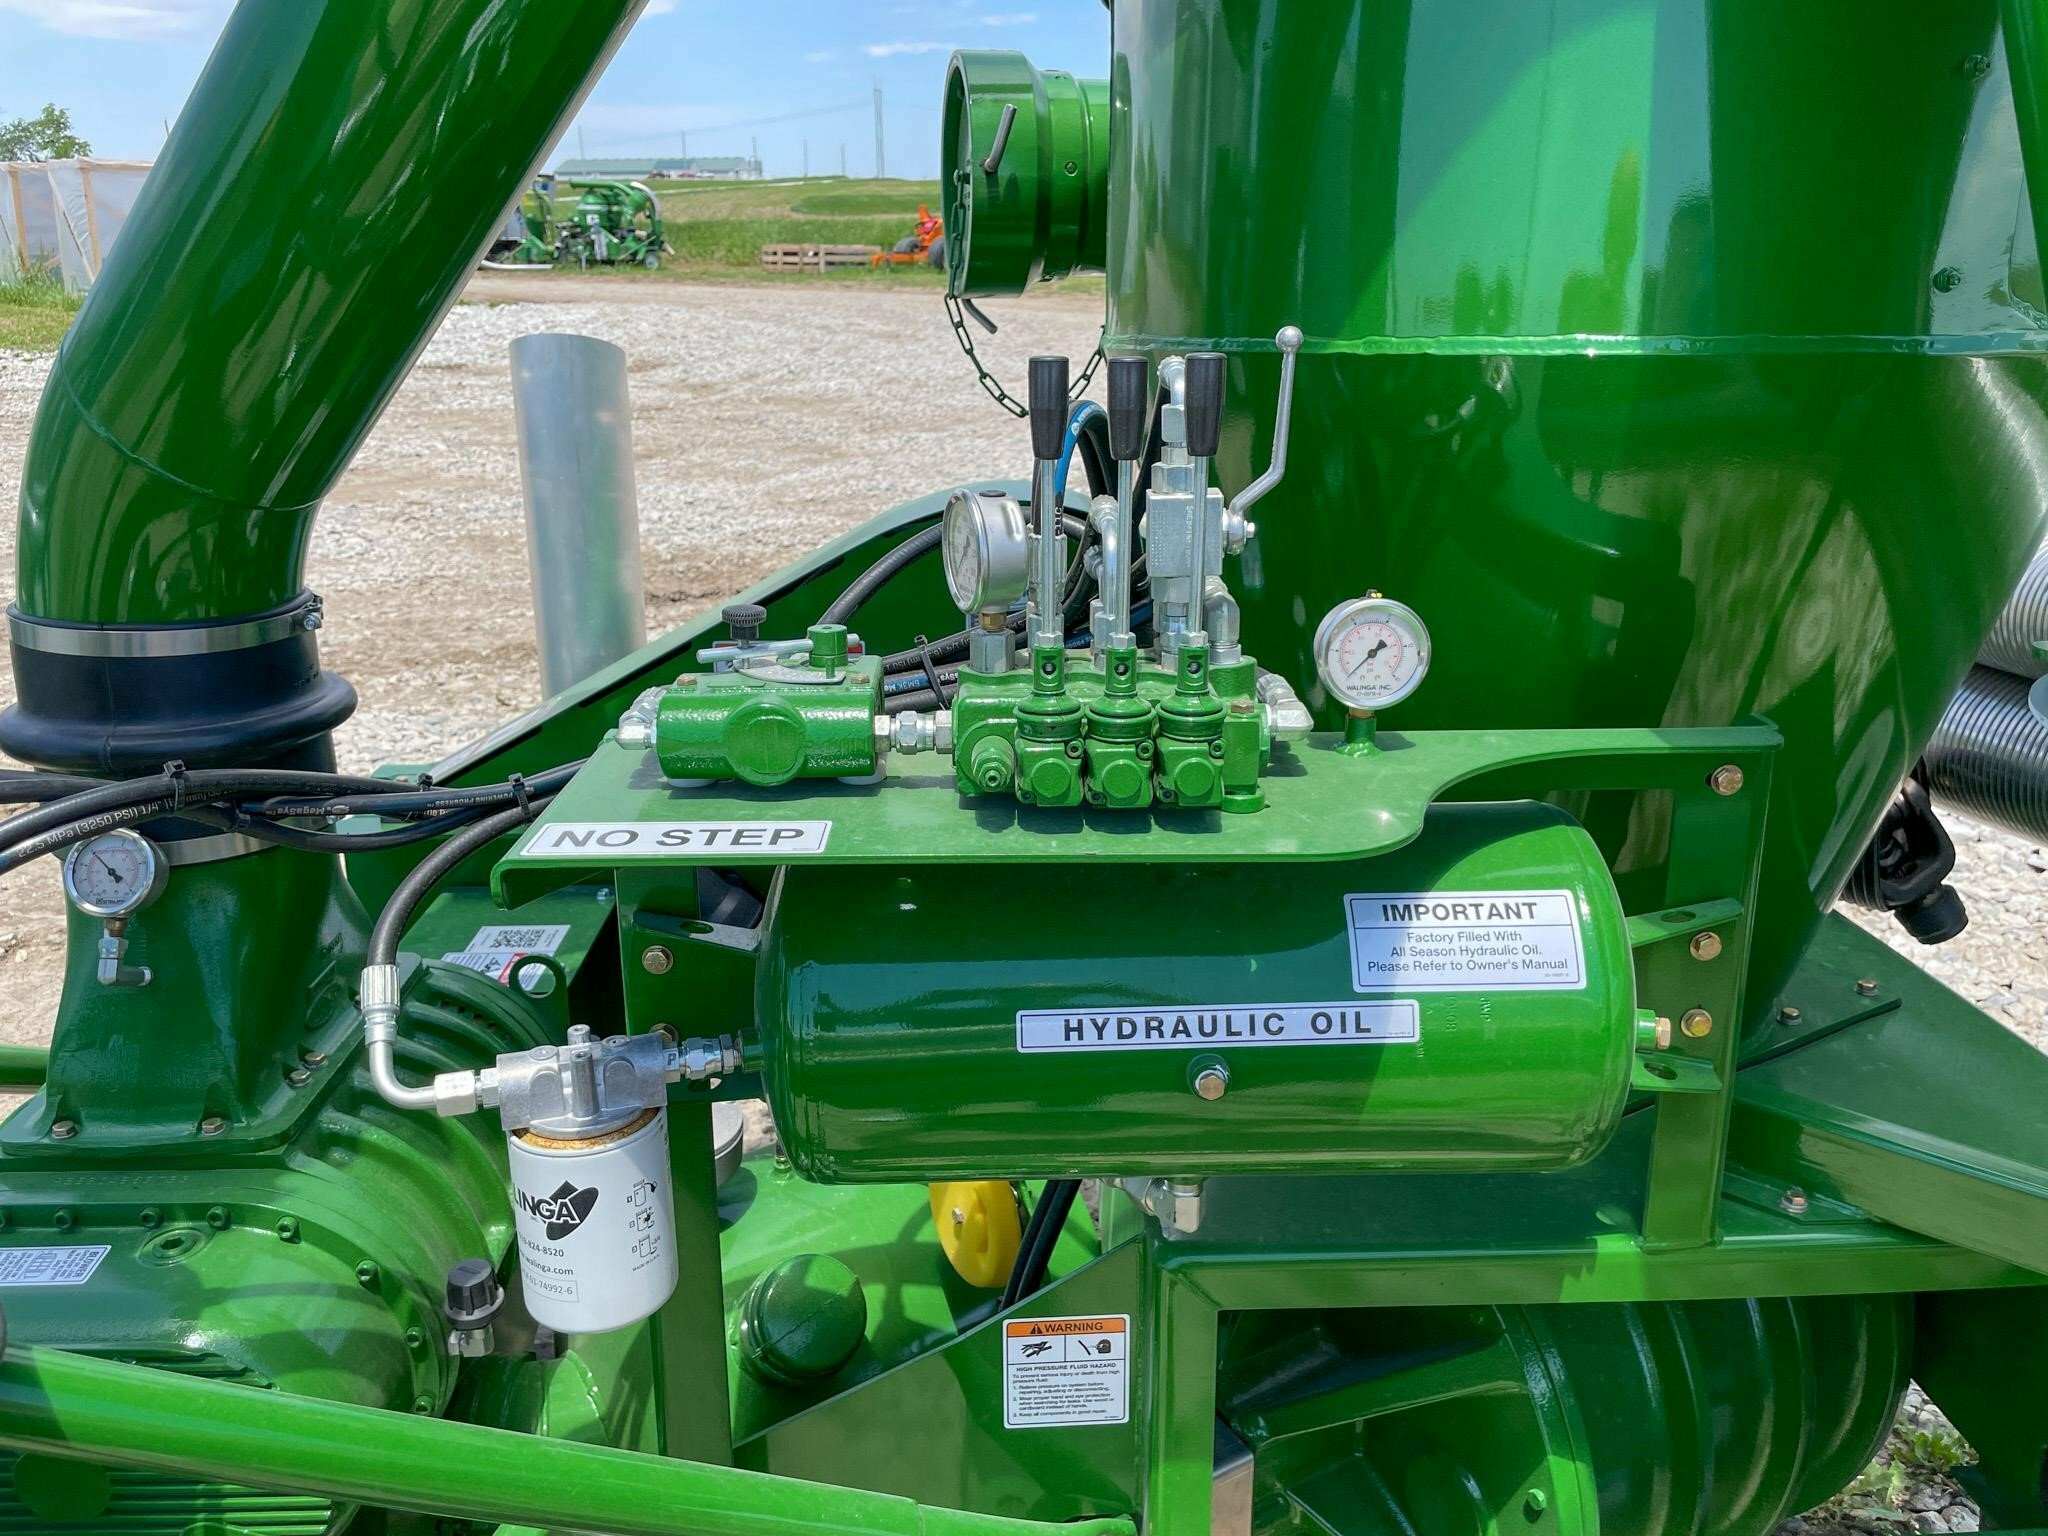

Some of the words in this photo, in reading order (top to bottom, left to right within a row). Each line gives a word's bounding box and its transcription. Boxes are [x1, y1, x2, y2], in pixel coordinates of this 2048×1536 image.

[47, 829, 74, 845] MPa
[551, 829, 640, 848] NO
[655, 828, 805, 846] STEP
[1382, 902, 1538, 922] IMPORTANT
[1407, 932, 1454, 944] Factory
[1458, 930, 1490, 942] Filled
[1492, 930, 1522, 942] With
[1390, 947, 1406, 957] All
[1409, 946, 1456, 957] Season
[1460, 945, 1519, 958] Hydraulic
[1521, 944, 1542, 955] Oil.
[1368, 961, 1409, 972] Please
[1413, 960, 1446, 971] Refer
[1450, 961, 1463, 971] to
[1467, 959, 1518, 971] Owner's
[1522, 958, 1568, 970] Manual
[1064, 1012, 1285, 1041] HYDRAULIC
[1310, 1011, 1372, 1035] OIL
[1045, 1322, 1103, 1333] WARNING
